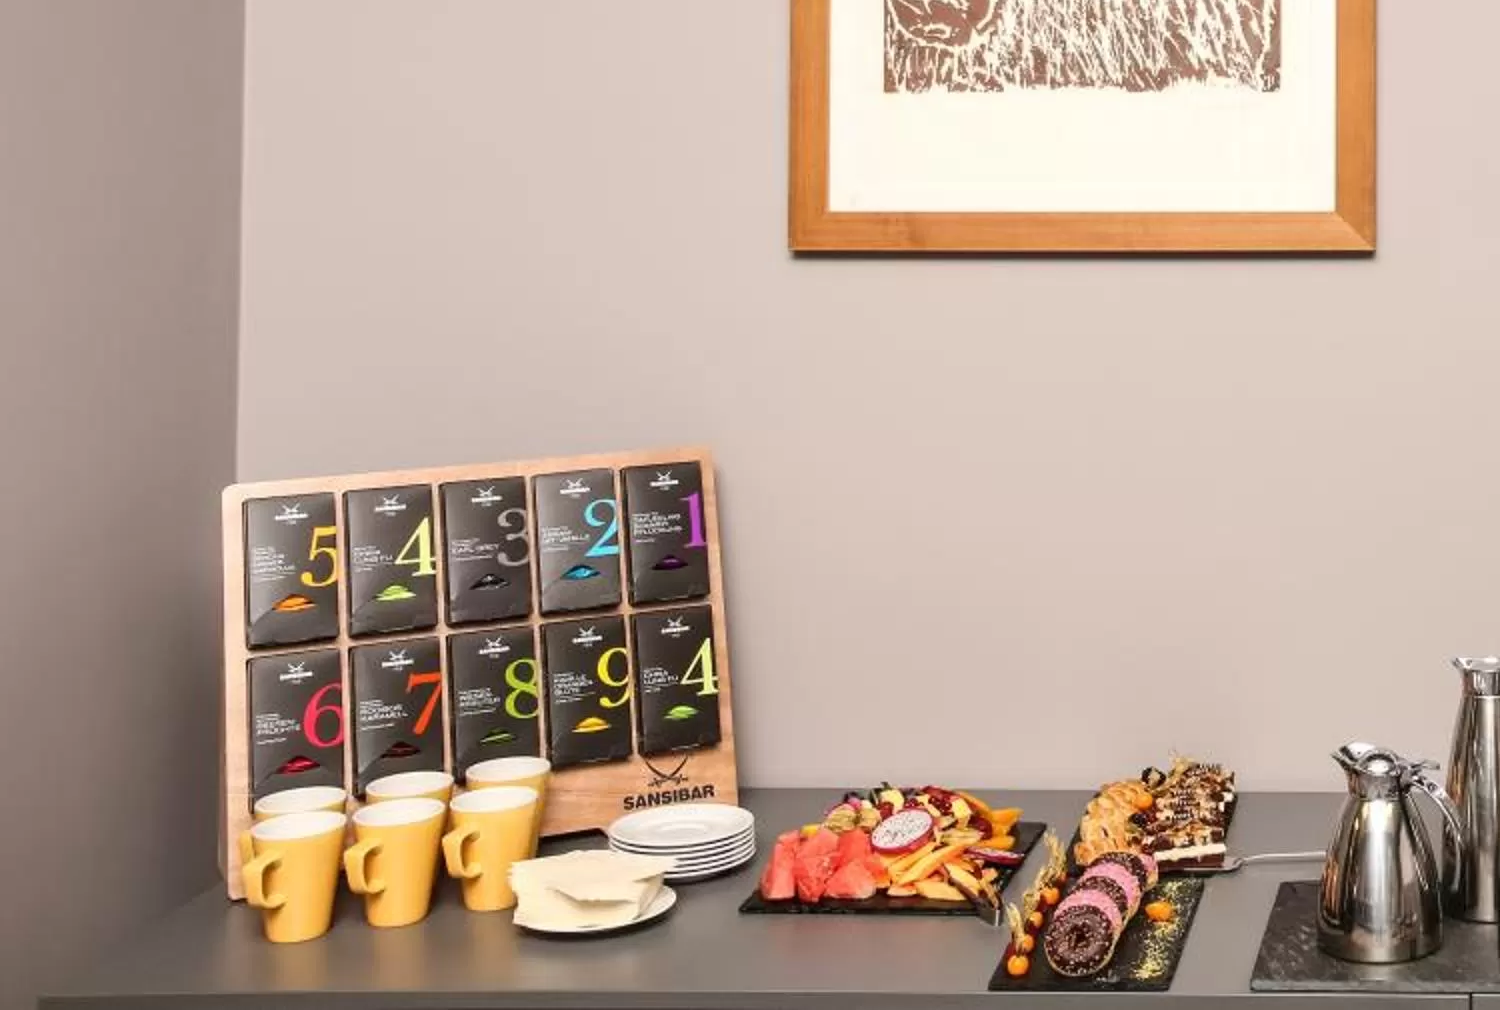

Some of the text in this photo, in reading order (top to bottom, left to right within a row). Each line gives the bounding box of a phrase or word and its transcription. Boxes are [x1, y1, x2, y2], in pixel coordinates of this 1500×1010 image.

[394, 517, 436, 577] 4
[497, 508, 528, 567] 3
[584, 499, 619, 556] 2
[680, 491, 707, 547] 1
[301, 525, 337, 587] 5
[505, 659, 539, 719] 8
[598, 647, 630, 707] 9
[681, 637, 718, 695] 4
[303, 682, 343, 747] 6
[405, 672, 441, 734] 7
[623, 784, 715, 810] SANSIBAR
